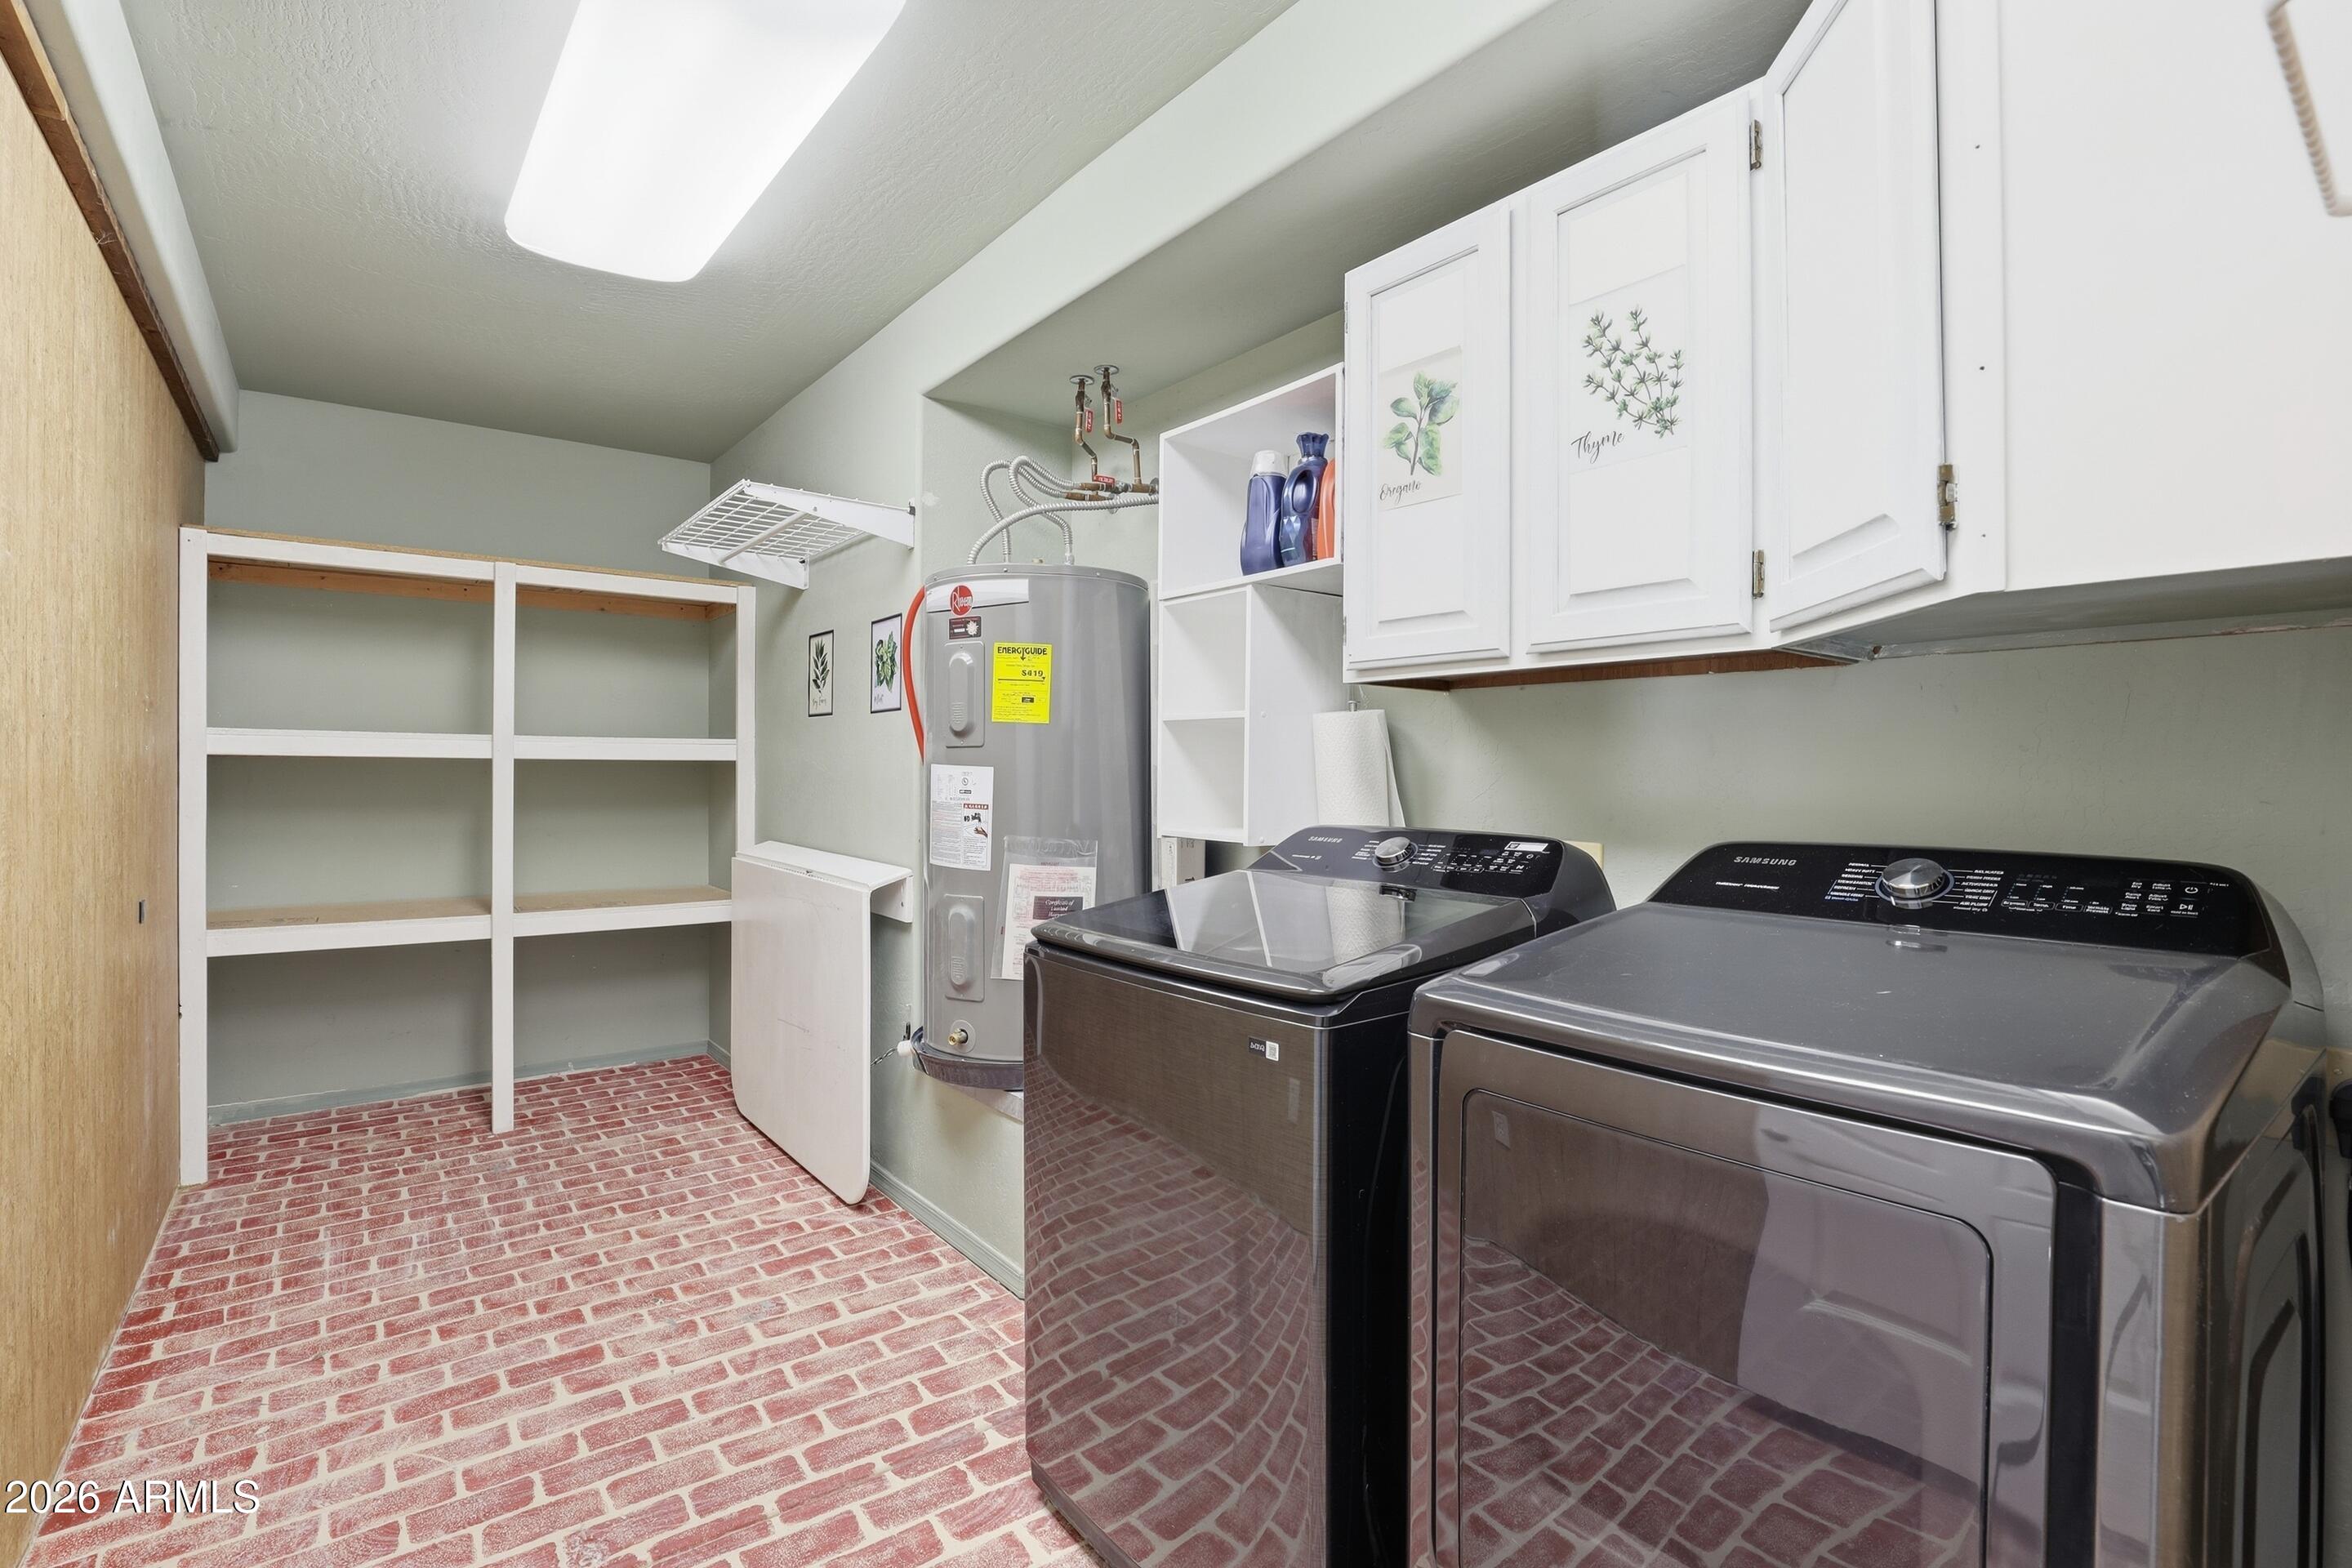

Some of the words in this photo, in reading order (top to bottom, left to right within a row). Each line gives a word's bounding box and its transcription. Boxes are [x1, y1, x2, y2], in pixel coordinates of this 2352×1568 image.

[1571, 430, 1625, 464] Thyme
[1379, 479, 1422, 502] Oregano
[951, 586, 973, 612] Rheem
[1734, 856, 1797, 866] SAMSUNG
